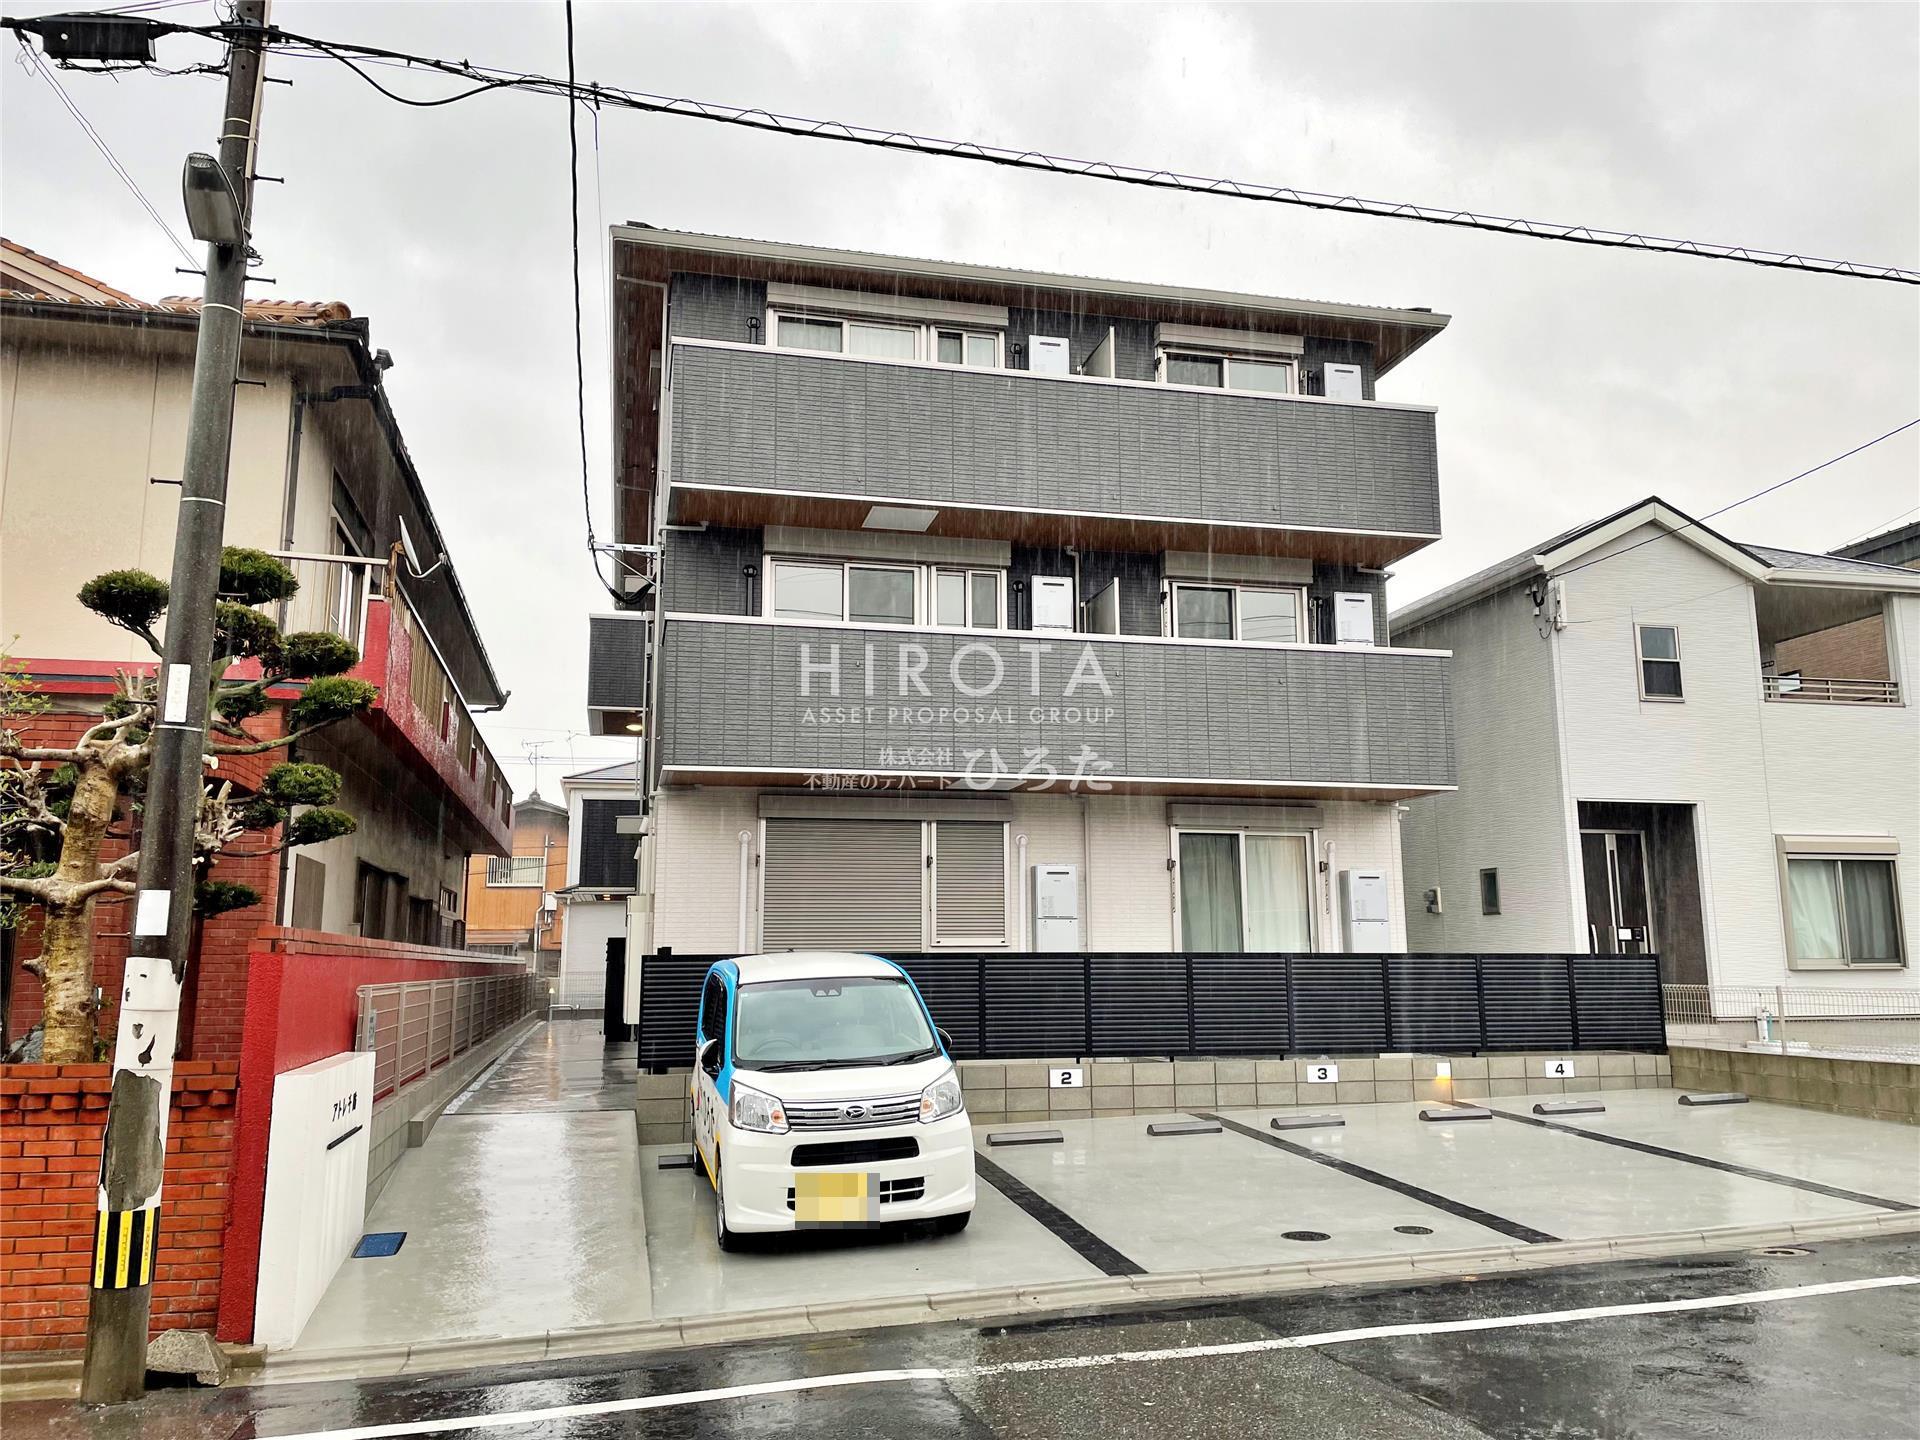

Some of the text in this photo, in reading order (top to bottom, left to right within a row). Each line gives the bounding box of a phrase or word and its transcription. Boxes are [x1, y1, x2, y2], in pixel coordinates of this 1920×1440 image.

[1317, 1067, 1328, 1080] 3
[1555, 1063, 1565, 1075] 4
[1061, 1071, 1072, 1085] 2
